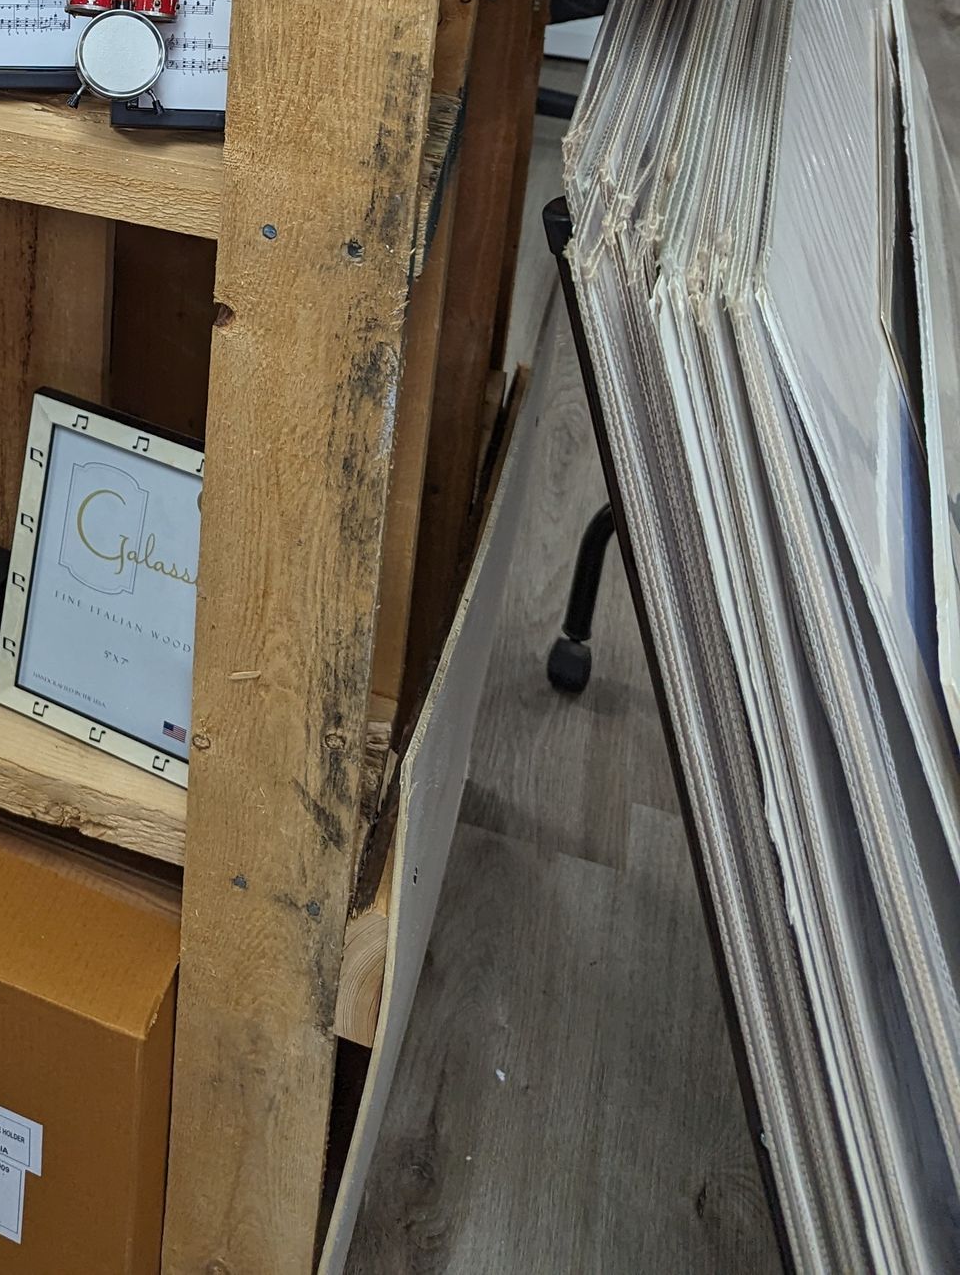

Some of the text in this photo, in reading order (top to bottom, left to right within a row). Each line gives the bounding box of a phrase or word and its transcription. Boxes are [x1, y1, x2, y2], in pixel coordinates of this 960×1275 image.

[76, 488, 199, 585] Galass
[89, 603, 143, 633] ITALIAN
[150, 628, 192, 654] WOOD
[2, 1127, 25, 1144] HOLDER
